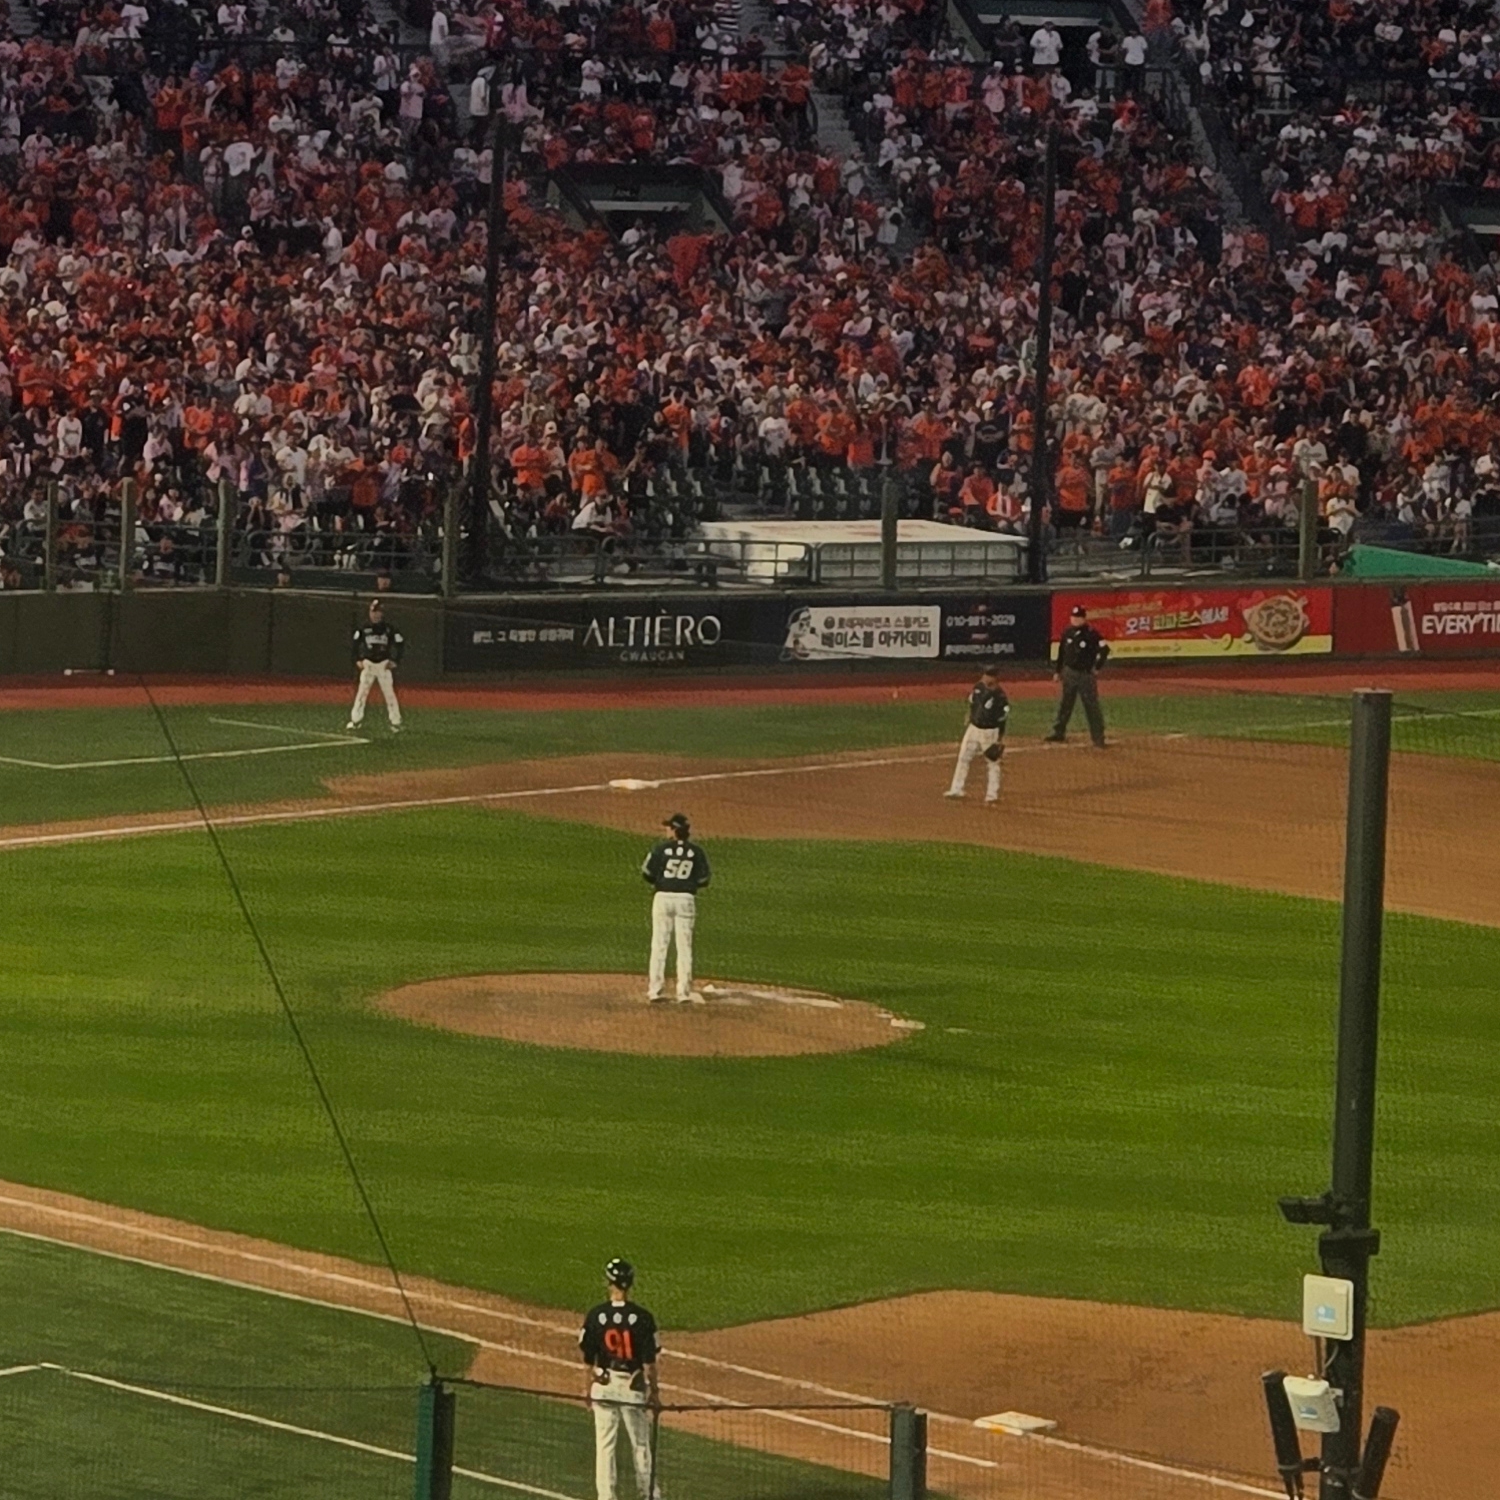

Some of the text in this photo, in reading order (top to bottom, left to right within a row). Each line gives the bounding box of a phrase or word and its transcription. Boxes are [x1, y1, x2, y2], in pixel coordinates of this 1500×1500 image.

[1125, 616, 1151, 634] 오직
[1422, 612, 1500, 635] EVERY'TI
[821, 631, 932, 648] 베이스볼 아카데미
[663, 858, 694, 880] 58
[603, 1328, 635, 1361] 91
